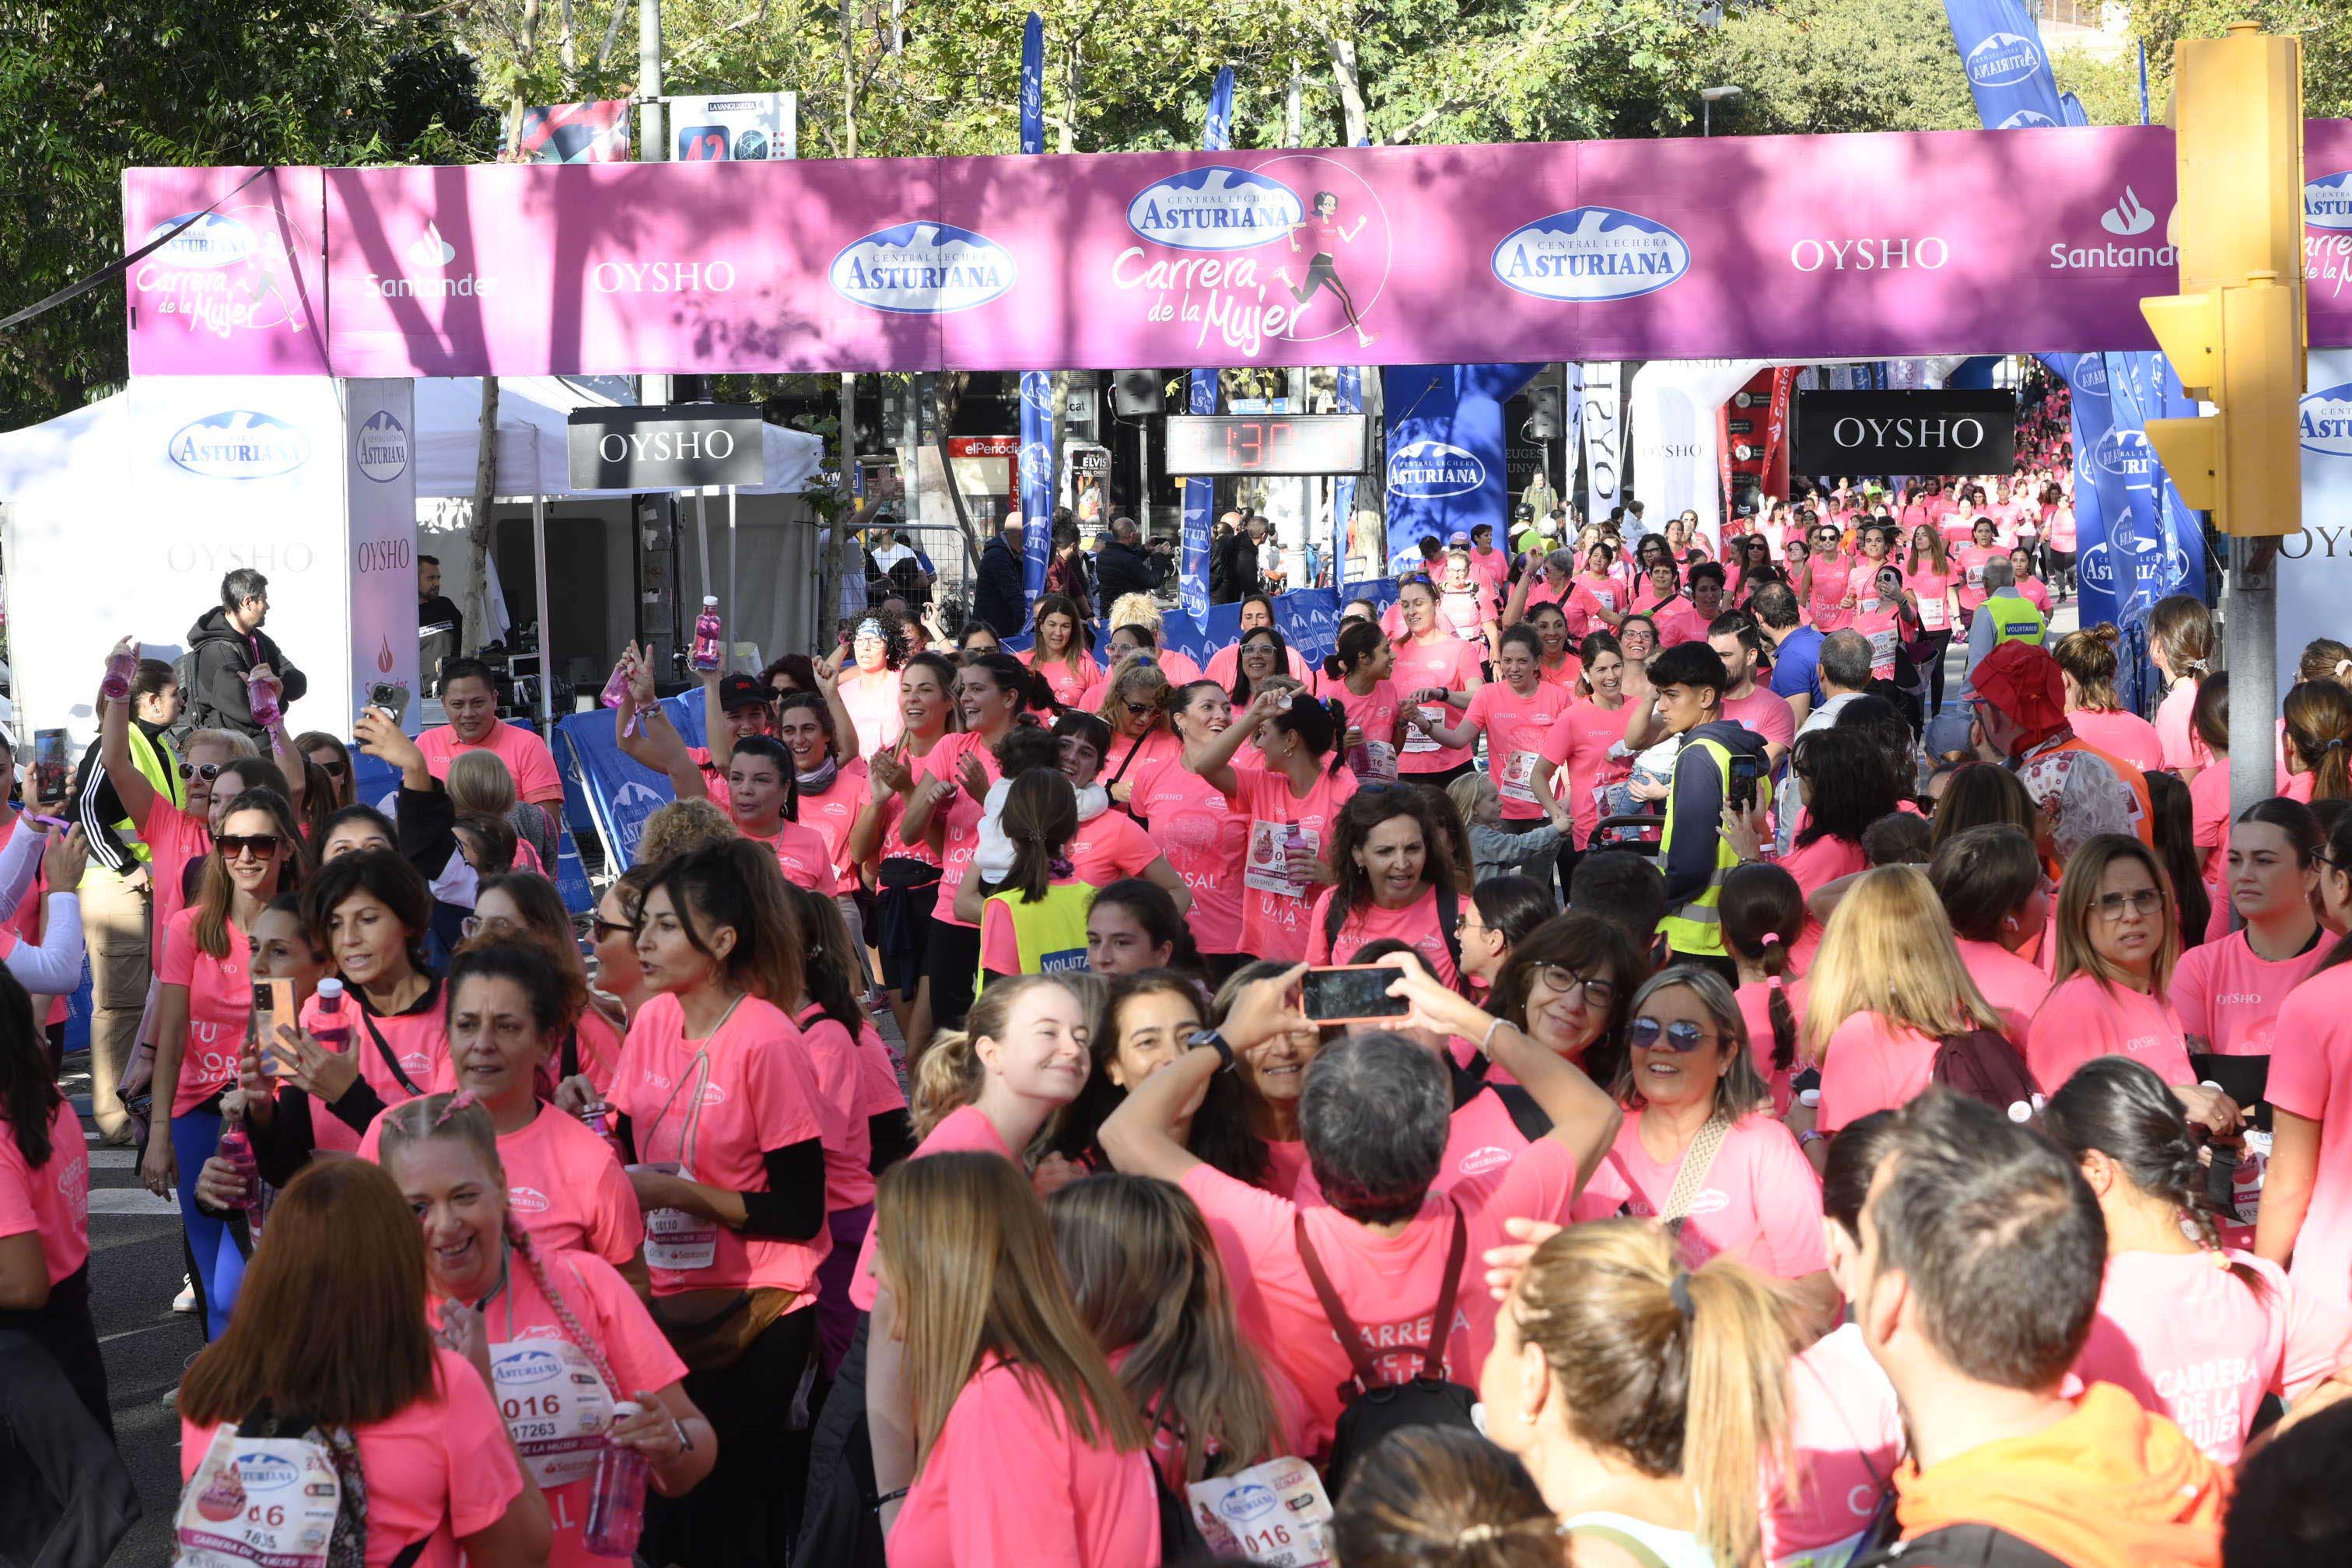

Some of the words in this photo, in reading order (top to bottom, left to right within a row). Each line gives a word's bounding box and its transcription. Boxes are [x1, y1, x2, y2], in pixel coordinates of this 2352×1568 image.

[1141, 198, 1290, 230] ASTURIANA
[1168, 195, 1223, 205] CENTRAL
[872, 253, 932, 263] CENTRAL
[1538, 239, 1599, 250] CENTRAL
[1605, 237, 1669, 247] LECHERA
[1791, 236, 1948, 271] OYSHO
[845, 255, 1000, 290] ASTURIANA
[1112, 247, 1257, 290] Carrera
[1507, 243, 1675, 278] ASTURIANA
[2322, 257, 2337, 279] la
[136, 263, 228, 293] Carrera
[365, 272, 499, 298] Santander
[592, 261, 736, 293] OYSHO
[159, 296, 177, 315] de
[189, 289, 262, 338] Mujer
[1147, 299, 1175, 324] de
[1181, 292, 1201, 323] la
[1198, 285, 1311, 358] Mujer
[599, 429, 734, 463] OYSHO
[1833, 417, 1985, 450] OYSHO
[360, 438, 405, 466] ASTURIANA
[1083, 457, 1108, 467] ELVIS
[1390, 465, 1479, 486] ASTURIANA
[166, 542, 314, 574] OYSHO
[358, 538, 410, 573] OYSHO
[190, 1020, 219, 1043] TU
[1332, 1308, 1472, 1349] ARREA
[495, 1363, 559, 1380] ASTURIANA
[503, 1394, 561, 1419] 016
[2177, 1393, 2207, 1424] DE
[2214, 1387, 2240, 1417] LA
[513, 1422, 557, 1439] 17263
[532, 1444, 544, 1453] LA
[547, 1440, 579, 1451] MUJER
[191, 1534, 238, 1552] CARRERA
[1244, 1524, 1291, 1554] 016
